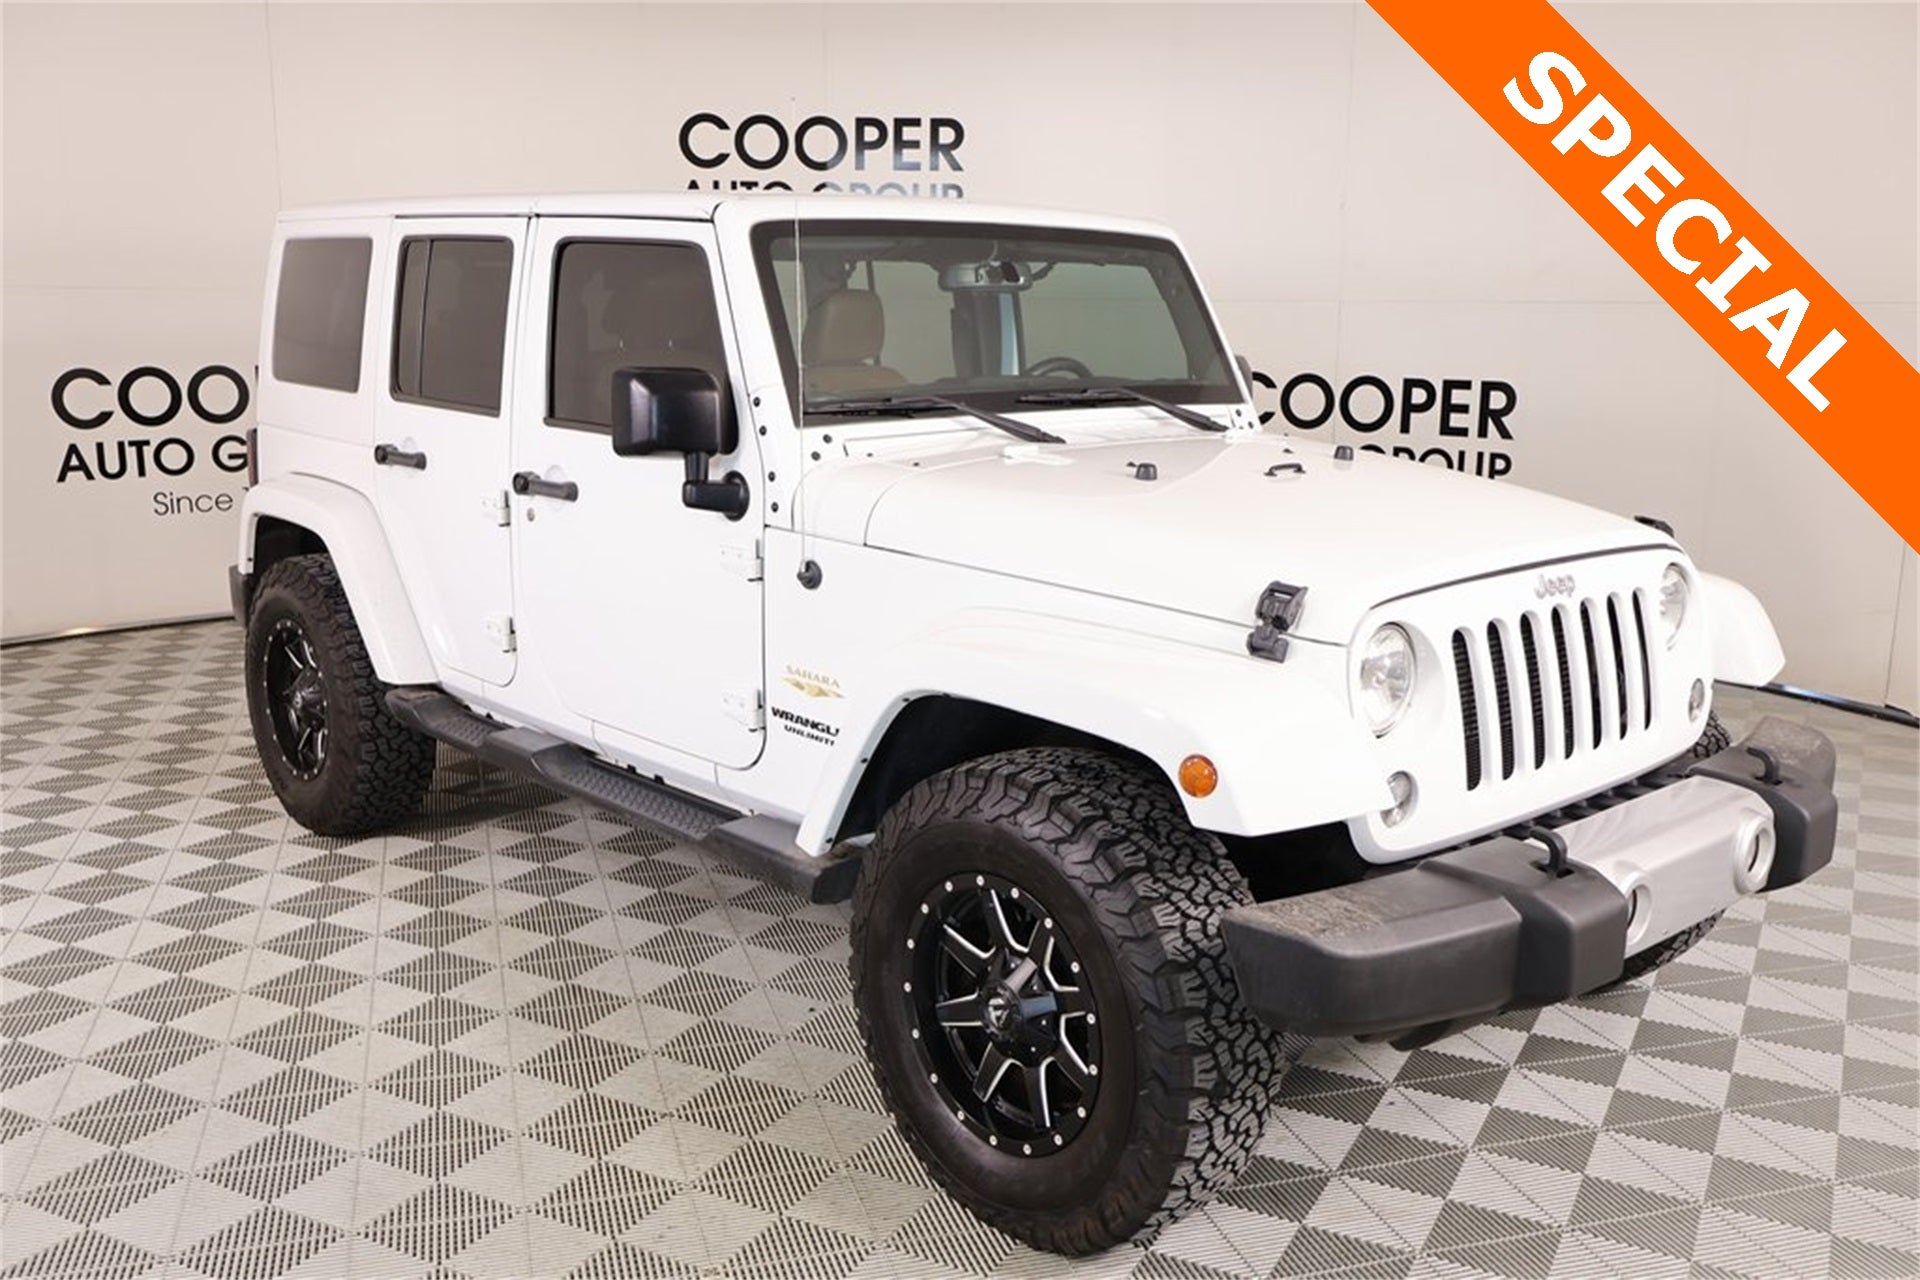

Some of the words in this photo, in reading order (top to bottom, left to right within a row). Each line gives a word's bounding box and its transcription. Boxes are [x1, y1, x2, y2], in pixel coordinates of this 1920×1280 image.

[678, 112, 965, 172] COOPER
[51, 365, 258, 430] COO
[57, 436, 195, 483] AUTO
[212, 435, 249, 473] G
[153, 491, 234, 516] Since
[1534, 573, 1576, 600] Jeep
[786, 664, 841, 689] SAHARA
